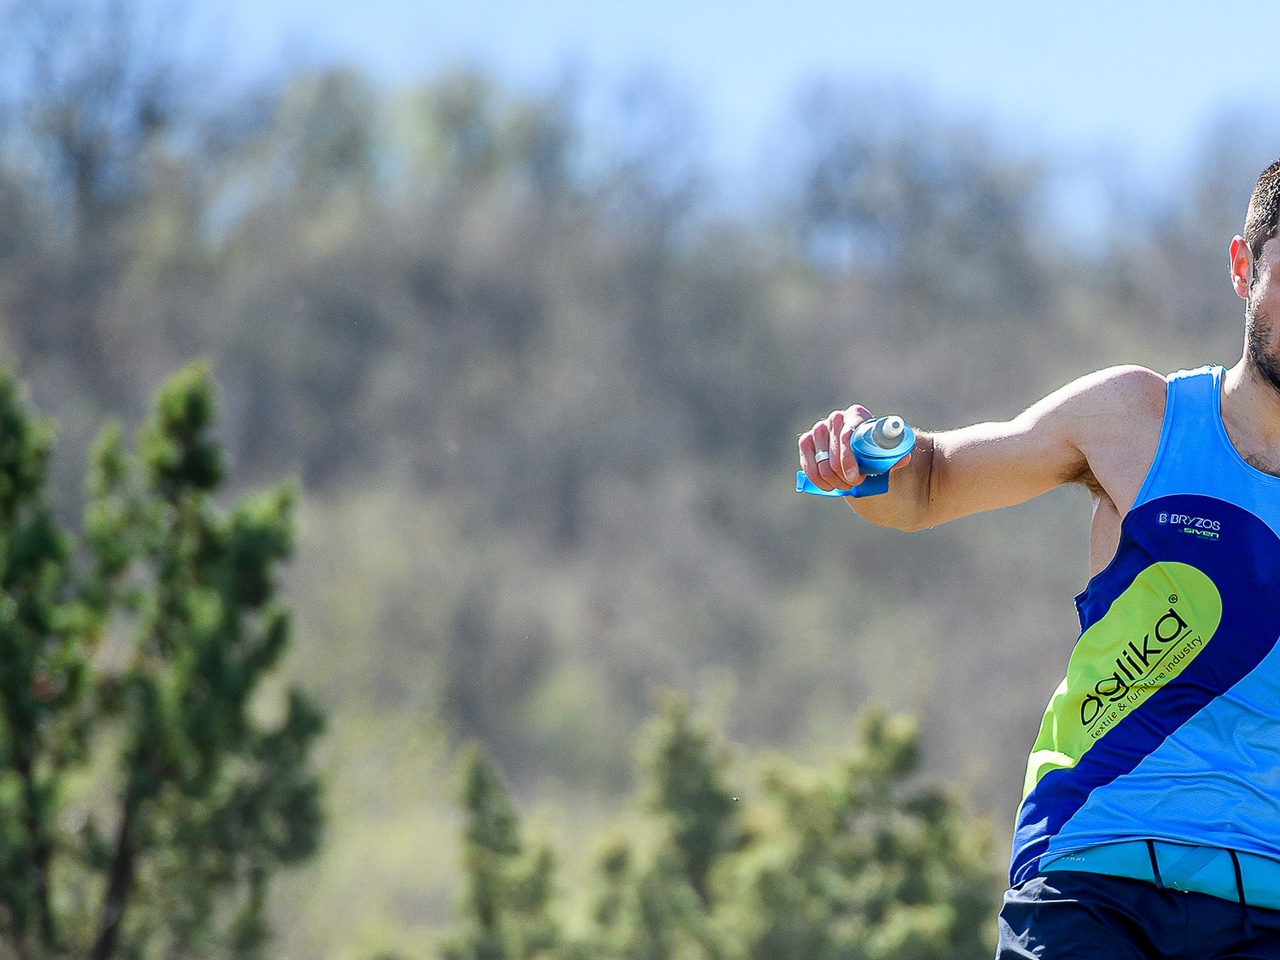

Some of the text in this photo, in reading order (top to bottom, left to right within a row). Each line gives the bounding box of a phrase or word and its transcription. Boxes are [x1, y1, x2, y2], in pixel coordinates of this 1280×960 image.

[1170, 513, 1221, 531] BRYZOS
[1081, 608, 1188, 726] aglika
[1090, 635, 1203, 739] textile & furniture industry
